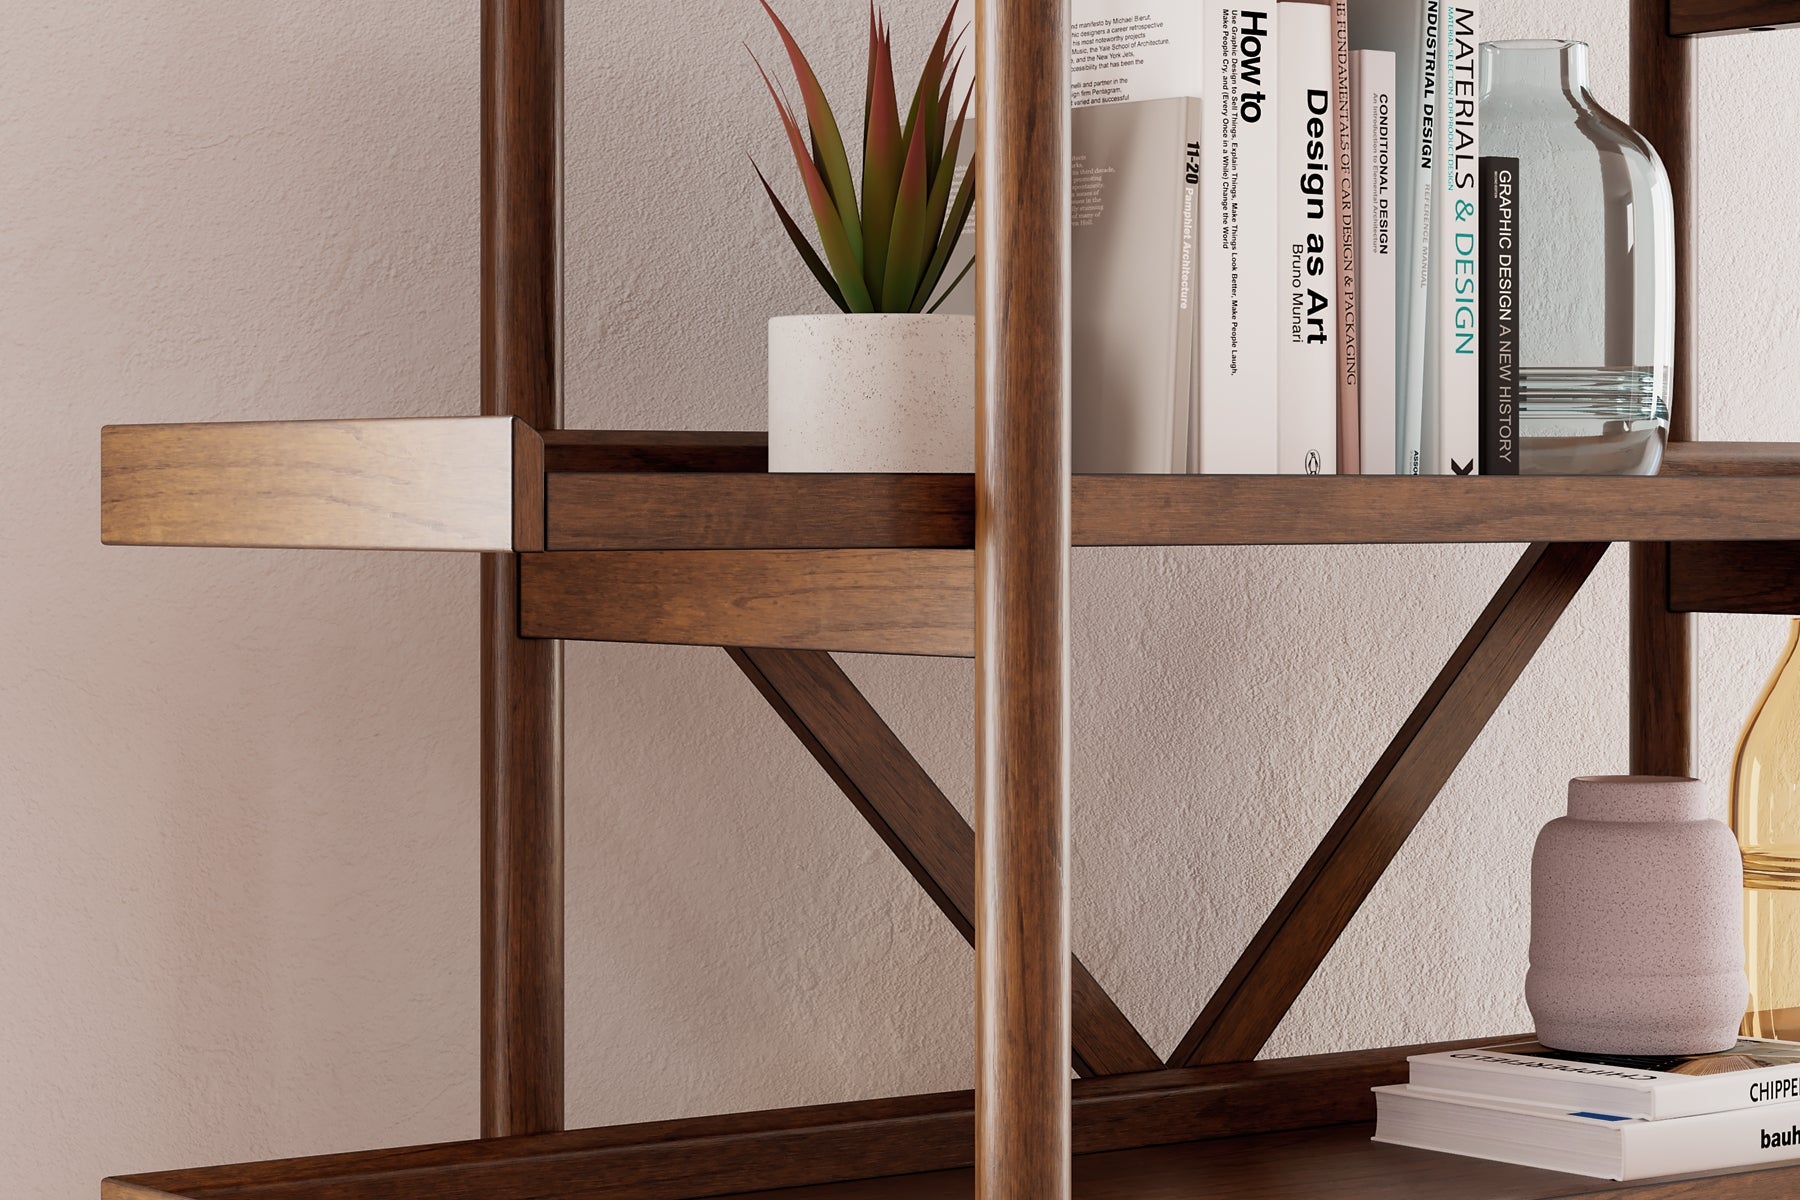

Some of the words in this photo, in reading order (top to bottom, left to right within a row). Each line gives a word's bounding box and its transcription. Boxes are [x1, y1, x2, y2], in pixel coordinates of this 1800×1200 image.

[1080, 29, 1105, 37] designers
[1129, 22, 1163, 30] retrospective
[1112, 16, 1133, 24] Michael
[1095, 35, 1124, 43] noteworthy
[1125, 32, 1146, 40] projects
[1230, 26, 1238, 56] Graphic
[1240, 10, 1268, 86] How
[1093, 79, 1112, 87] partner
[1230, 58, 1238, 84] Design
[1336, 20, 1349, 150] FUNDAMENTALS
[1102, 95, 1129, 103] successful
[1240, 91, 1266, 123] to
[1373, 93, 1378, 104] An
[1455, 7, 1474, 189] MATERIALS
[1230, 113, 1238, 140] Things,
[1422, 104, 1434, 169] DESIGN
[1230, 143, 1238, 170] Explain
[1301, 89, 1329, 220] Design
[1373, 155, 1378, 163] to
[1380, 94, 1388, 194] CONDITIONAL
[1186, 141, 1200, 184] 11-20
[1340, 153, 1350, 174] OF
[1230, 173, 1238, 200] Things,
[1342, 178, 1351, 210] CAR
[1183, 187, 1194, 239] Pamphlet
[1422, 184, 1431, 243] REFERENCE
[1455, 199, 1474, 222] &
[1499, 170, 1512, 249] GRAPHIC
[1230, 225, 1238, 250] Things
[1380, 199, 1388, 254] DESIGN
[1306, 233, 1326, 276] as
[1342, 215, 1352, 271] DESIGN
[1180, 241, 1192, 309] Architecture
[1292, 244, 1304, 288] Bruno
[1344, 276, 1353, 287] &
[1455, 233, 1474, 354] DESIGN
[1499, 254, 1512, 320] DESIGN
[1292, 293, 1304, 343] Munari
[1306, 289, 1329, 345] Art
[1499, 324, 1512, 336] A
[1230, 322, 1238, 348] People
[1344, 291, 1356, 385] PACKAGING
[1230, 350, 1238, 376] Laugh,
[1499, 341, 1512, 380] NEW
[1499, 386, 1512, 462] HISTORY
[1450, 1053, 1658, 1080] CHIPPERFIELD
[1750, 1078, 1800, 1102] CHIPPE
[1761, 1125, 1800, 1149] bauh
